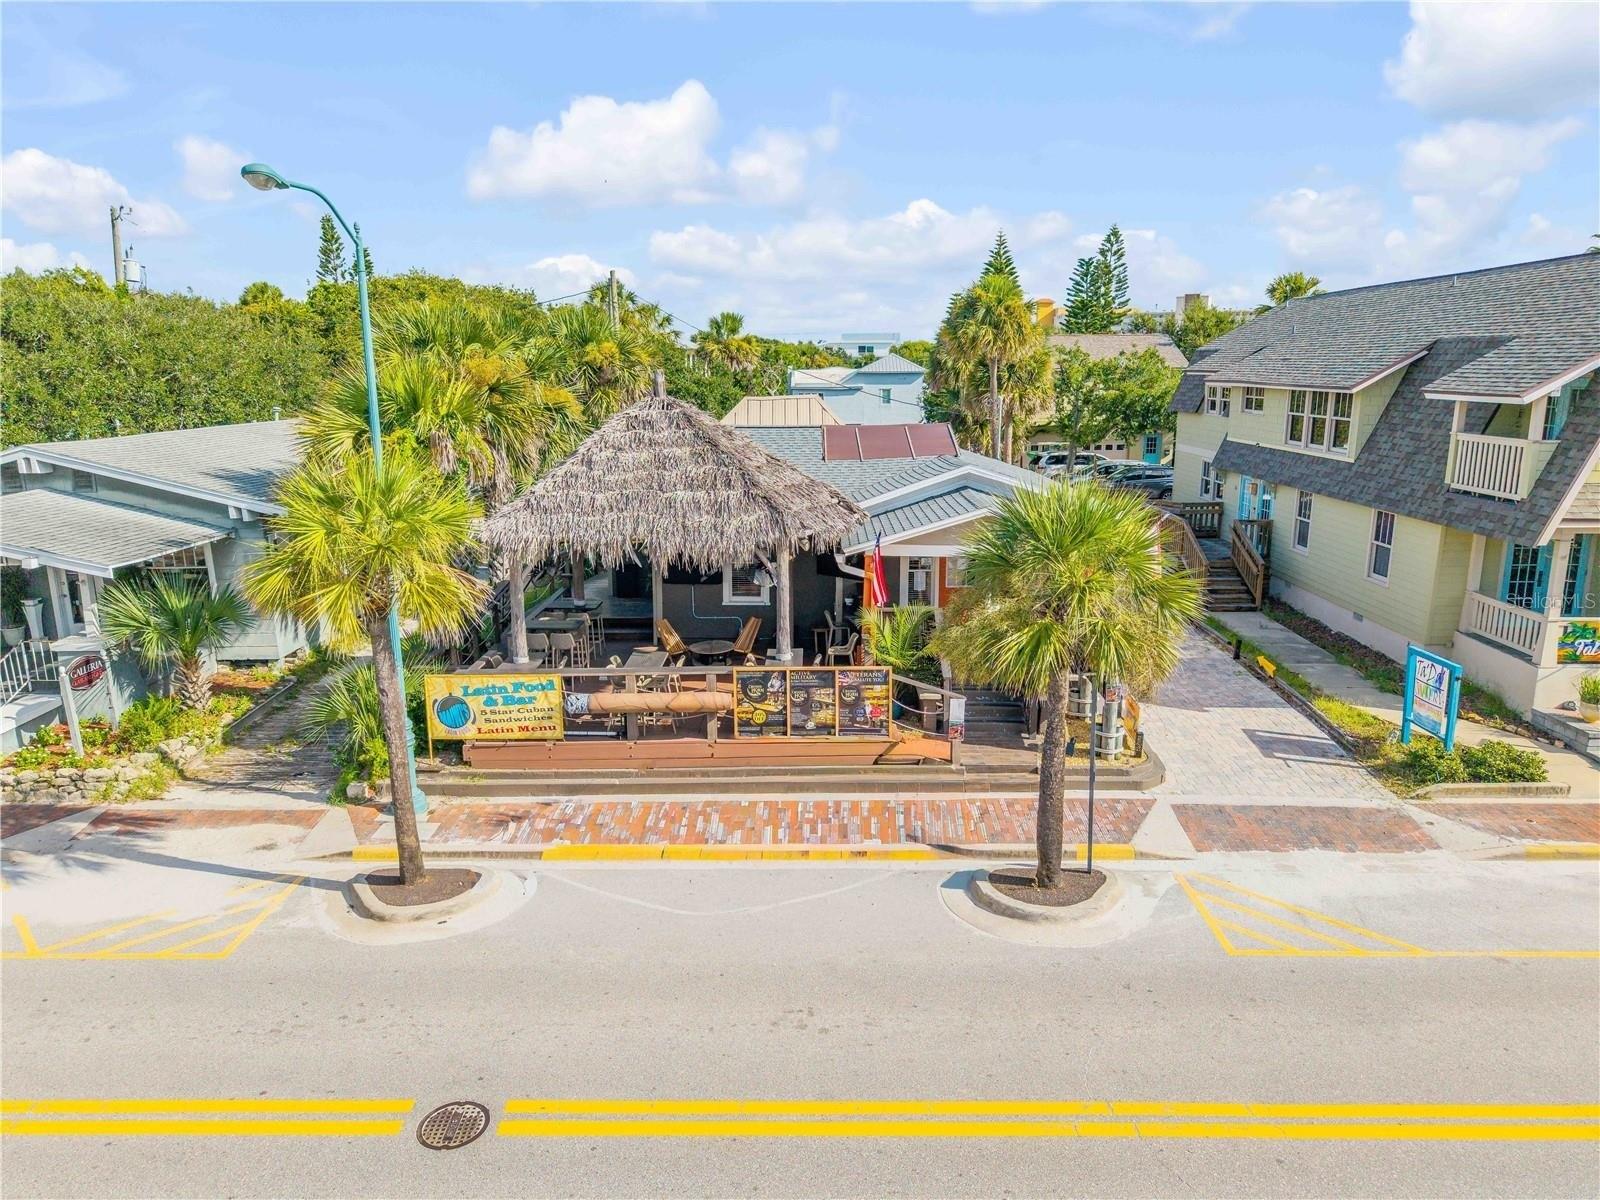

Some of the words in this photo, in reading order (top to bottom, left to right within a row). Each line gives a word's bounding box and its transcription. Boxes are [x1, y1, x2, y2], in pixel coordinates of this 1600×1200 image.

[70, 660, 103, 678] GALLERIA
[461, 684, 509, 697] Latin
[511, 679, 556, 693] Food
[483, 695, 499, 707] &
[501, 694, 537, 706] Bar
[489, 708, 515, 716] Star
[516, 706, 554, 714] Cuban
[483, 714, 554, 724] Sandwiches
[476, 726, 515, 735] Latin
[517, 724, 558, 733] Menu
